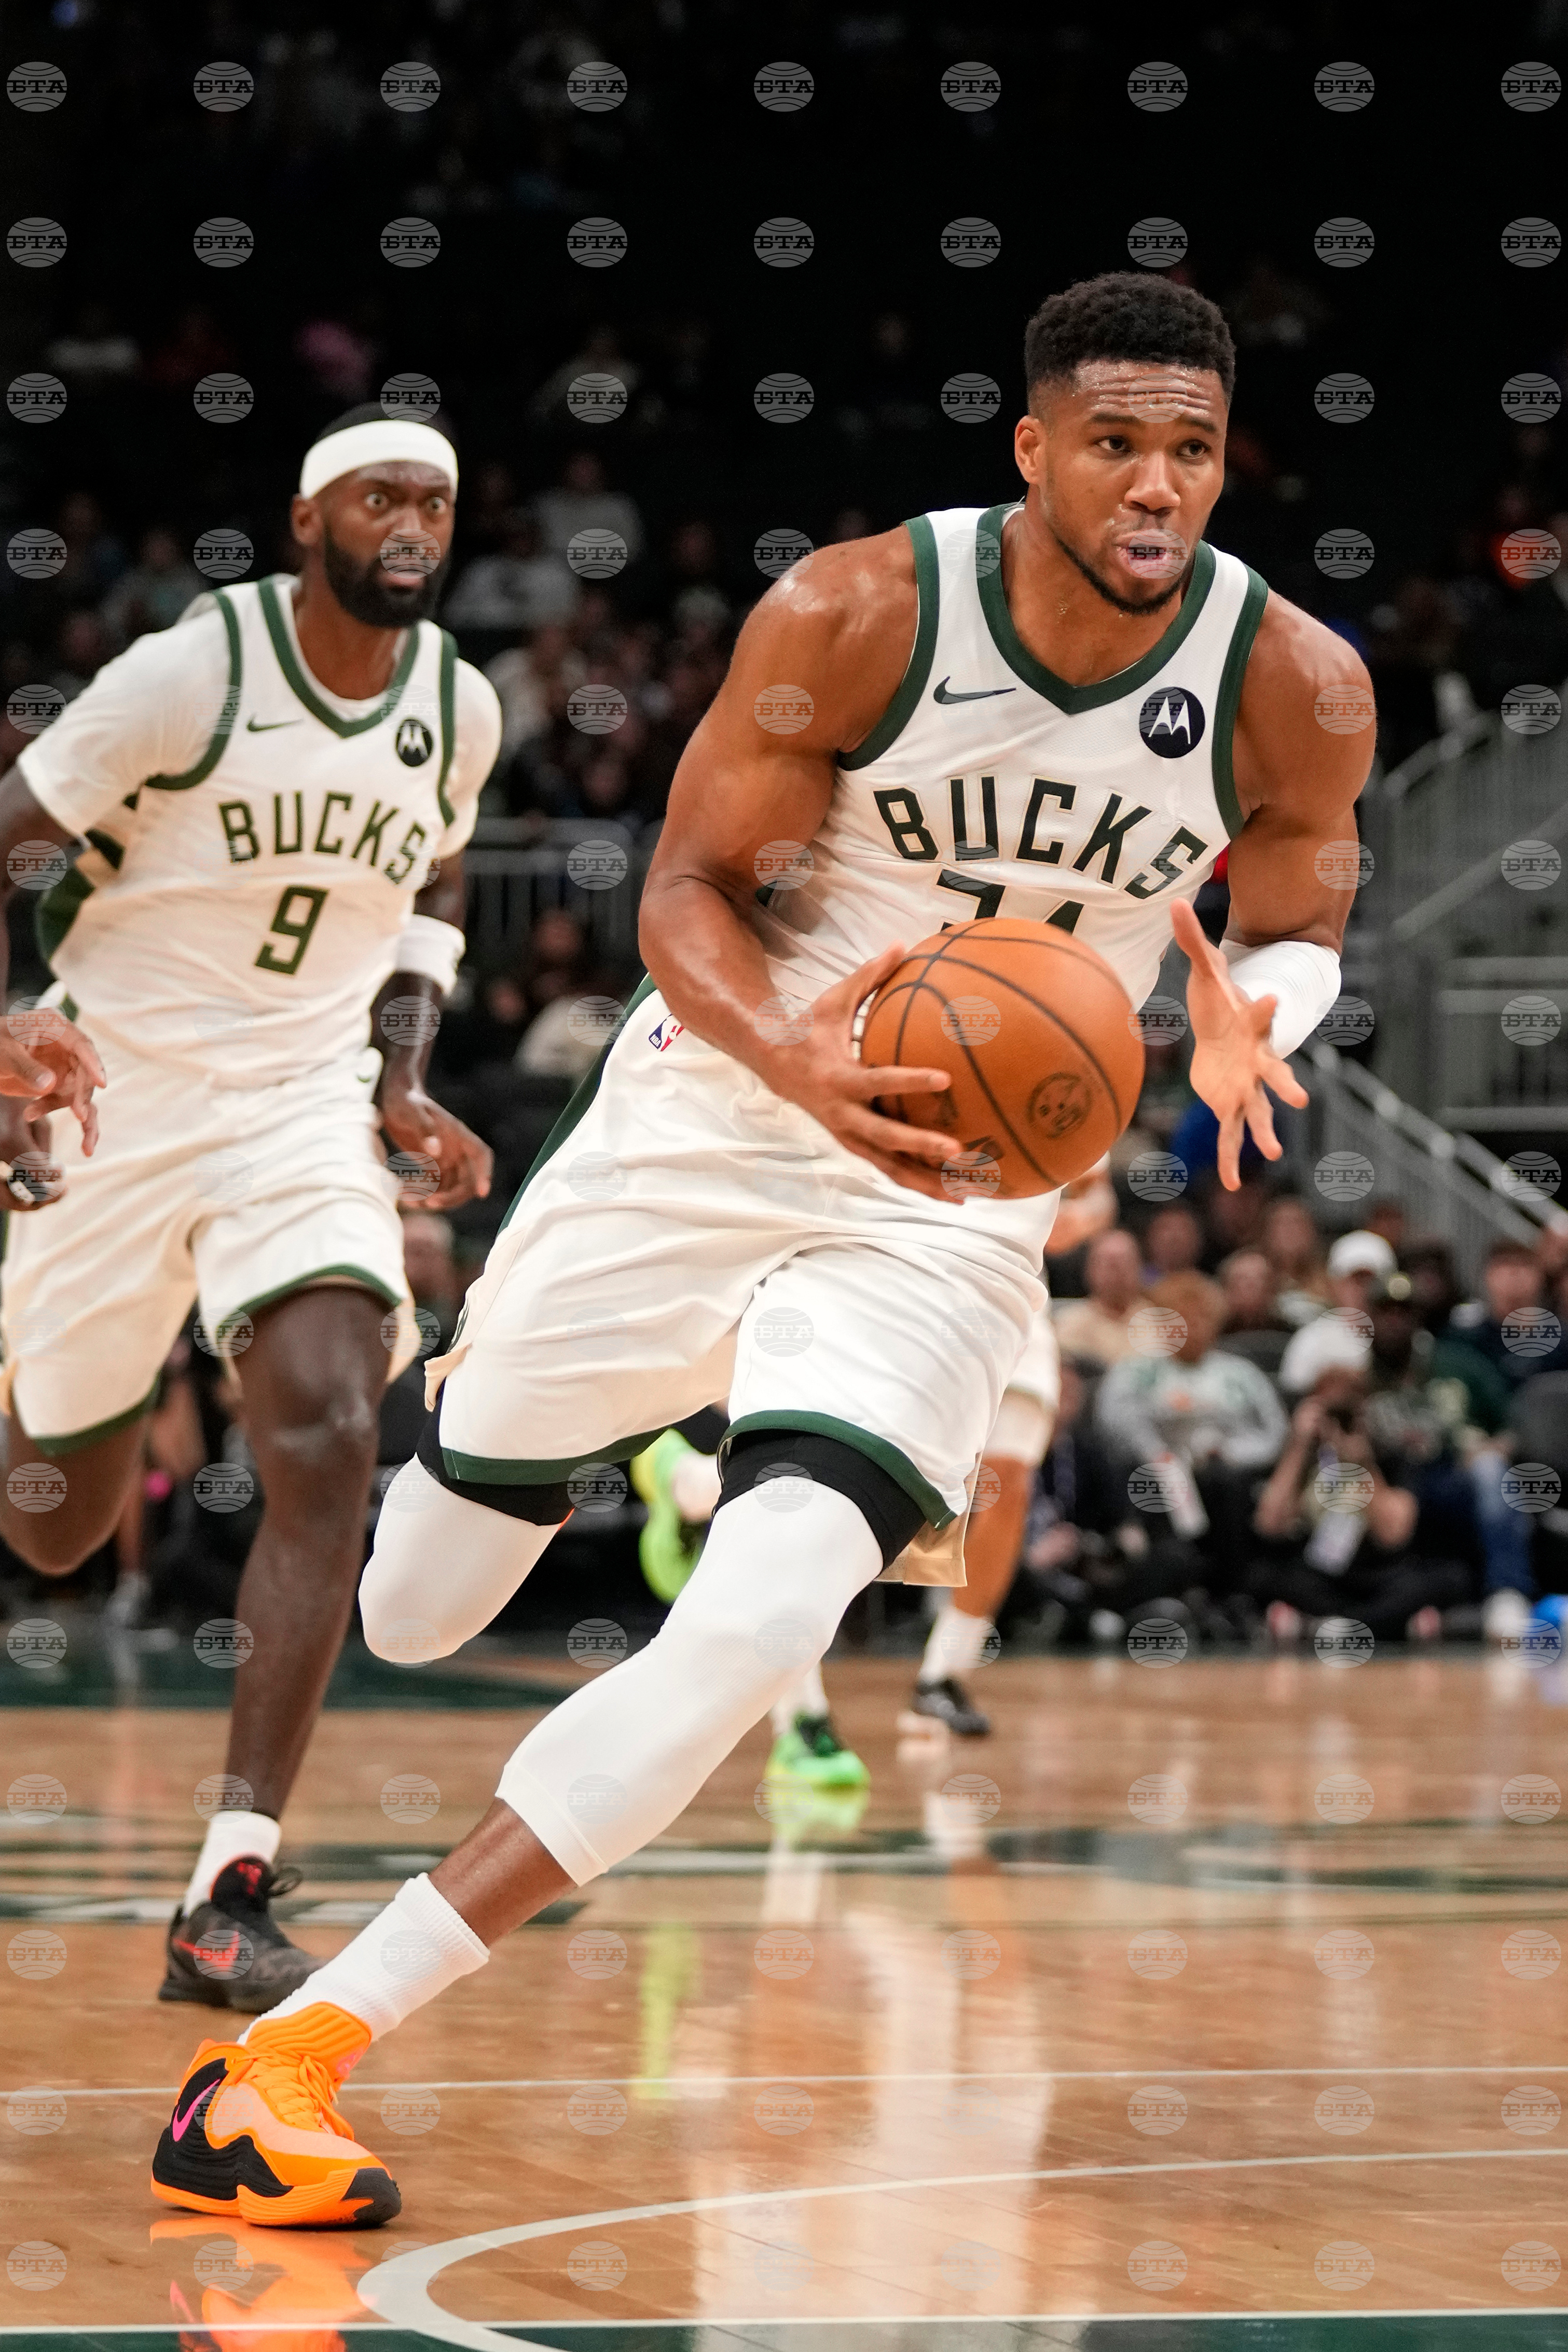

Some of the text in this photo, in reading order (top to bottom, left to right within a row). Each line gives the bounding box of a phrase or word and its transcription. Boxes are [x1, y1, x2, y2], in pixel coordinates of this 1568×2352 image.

[218, 790, 427, 885] BUCKS
[872, 774, 1211, 900] BUCKS
[255, 884, 330, 975] 9
[650, 1034, 662, 1047] NBA
